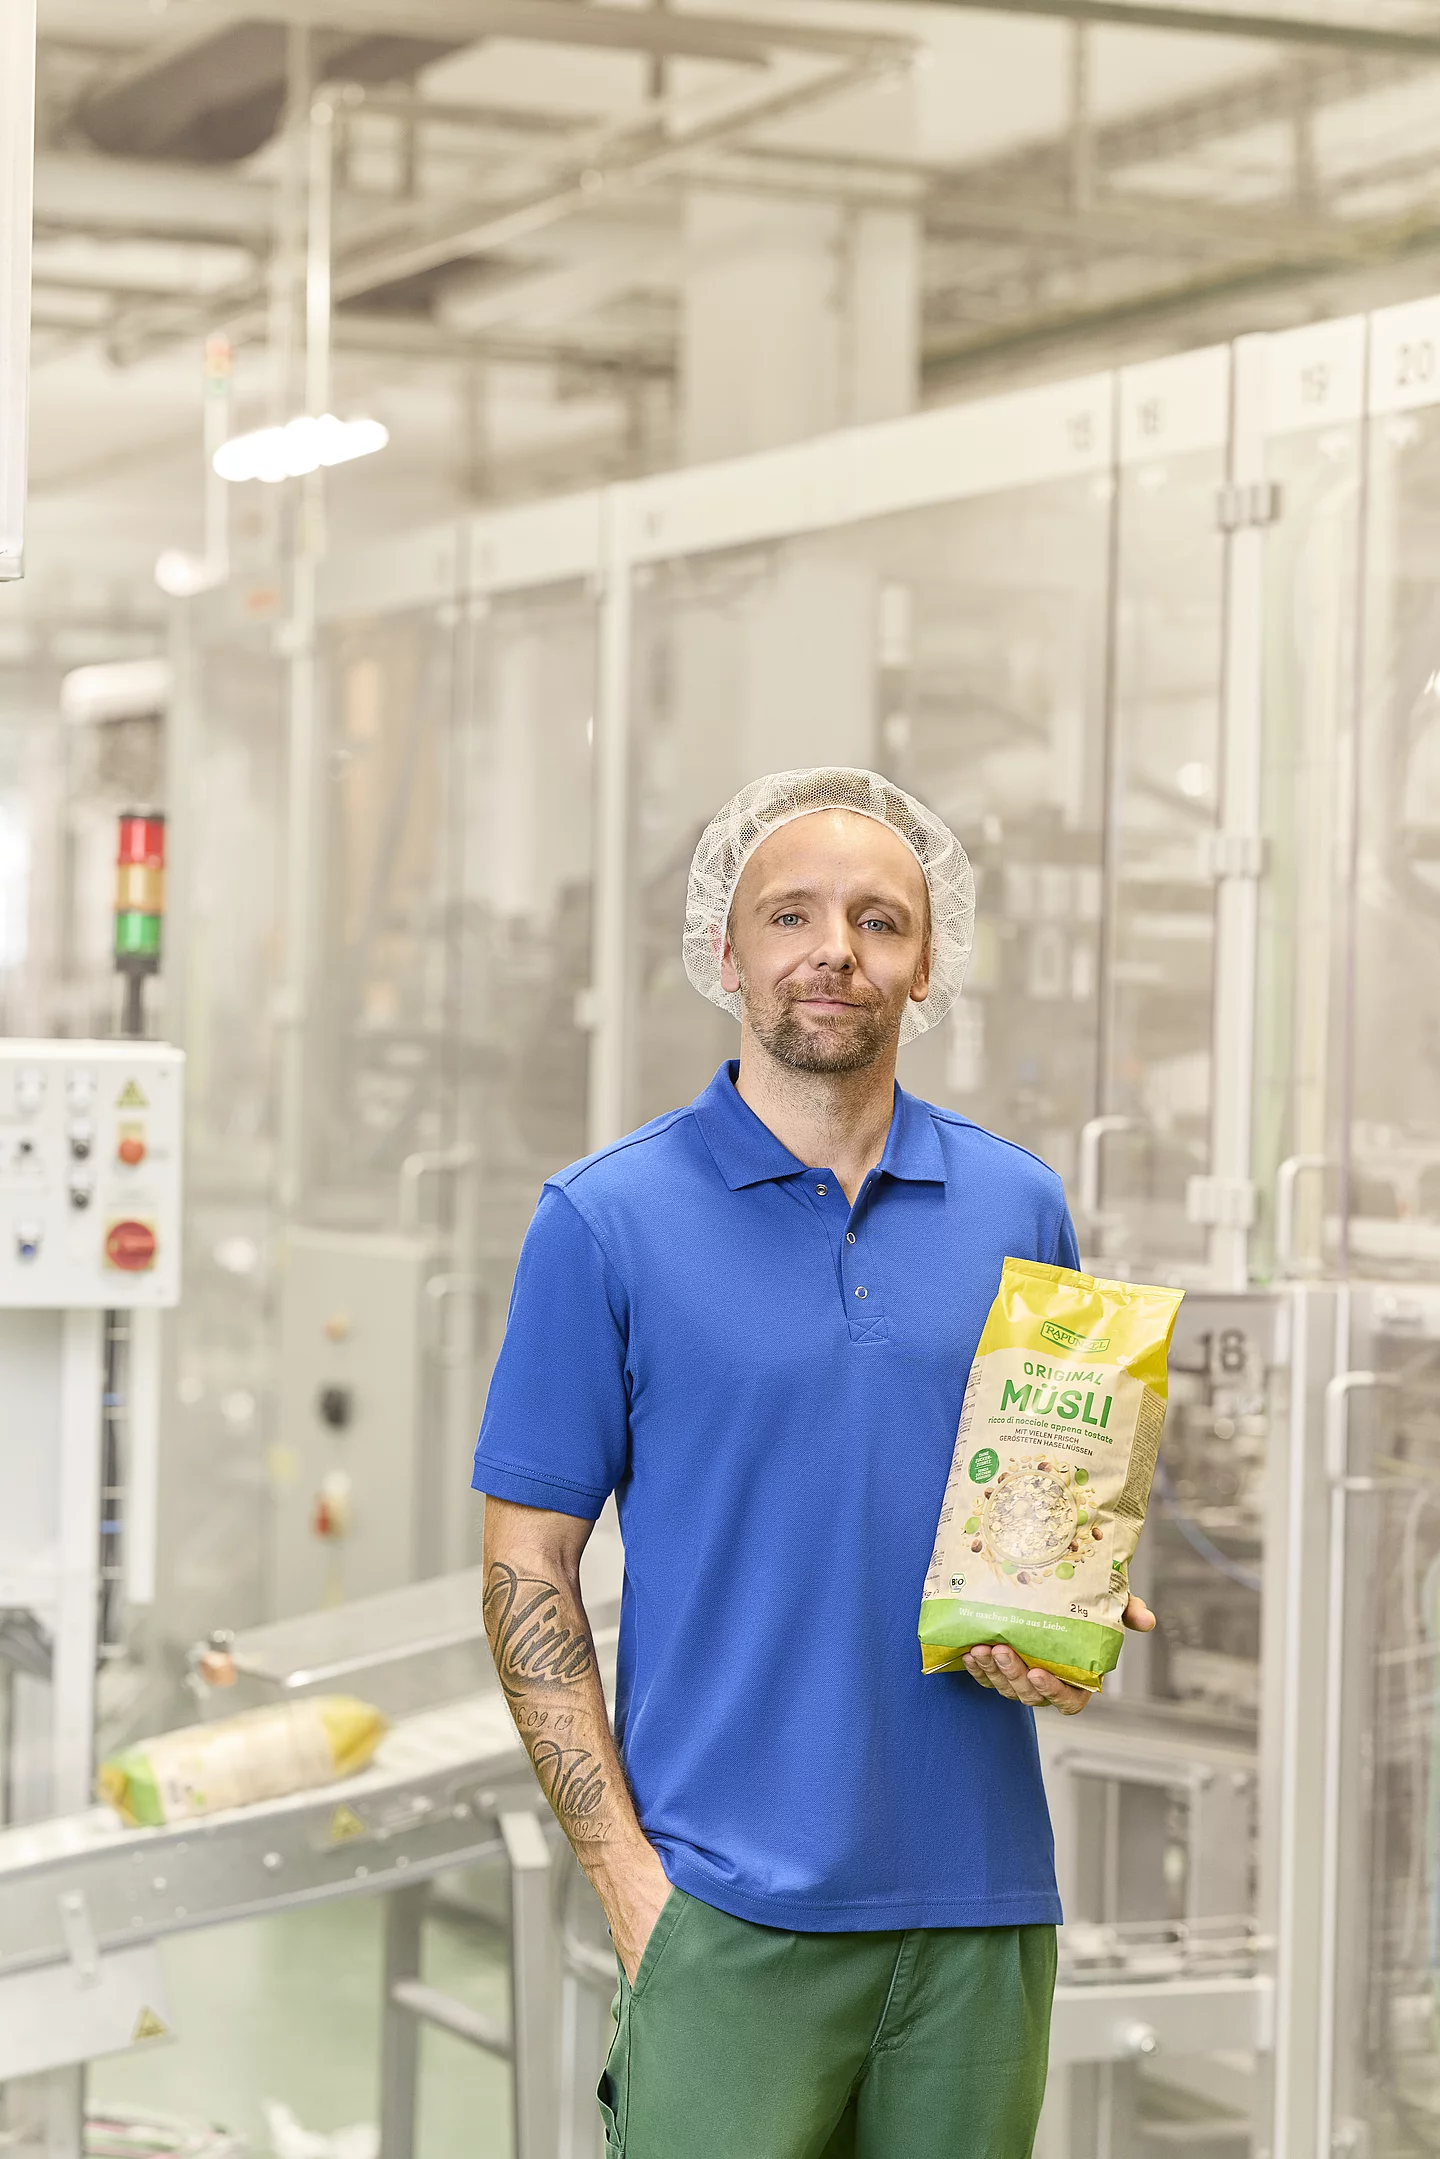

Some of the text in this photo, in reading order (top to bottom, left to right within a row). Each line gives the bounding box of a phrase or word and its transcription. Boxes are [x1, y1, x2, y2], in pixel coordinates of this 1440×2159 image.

[1193, 1329, 1248, 1373] 18
[1023, 1361, 1104, 1385] ORIGINAL
[1000, 1379, 1113, 1428] MÜSLI
[988, 1416, 1113, 1444] ricco di nocciole appena tostate
[1028, 1430, 1053, 1439] VIELEN
[1053, 1434, 1080, 1444] FRISCH
[999, 1435, 1094, 1456] GERÖSTETEN HASELNÜSSEN
[959, 1607, 1068, 1632] Wir machen Bio aus Liebe.
